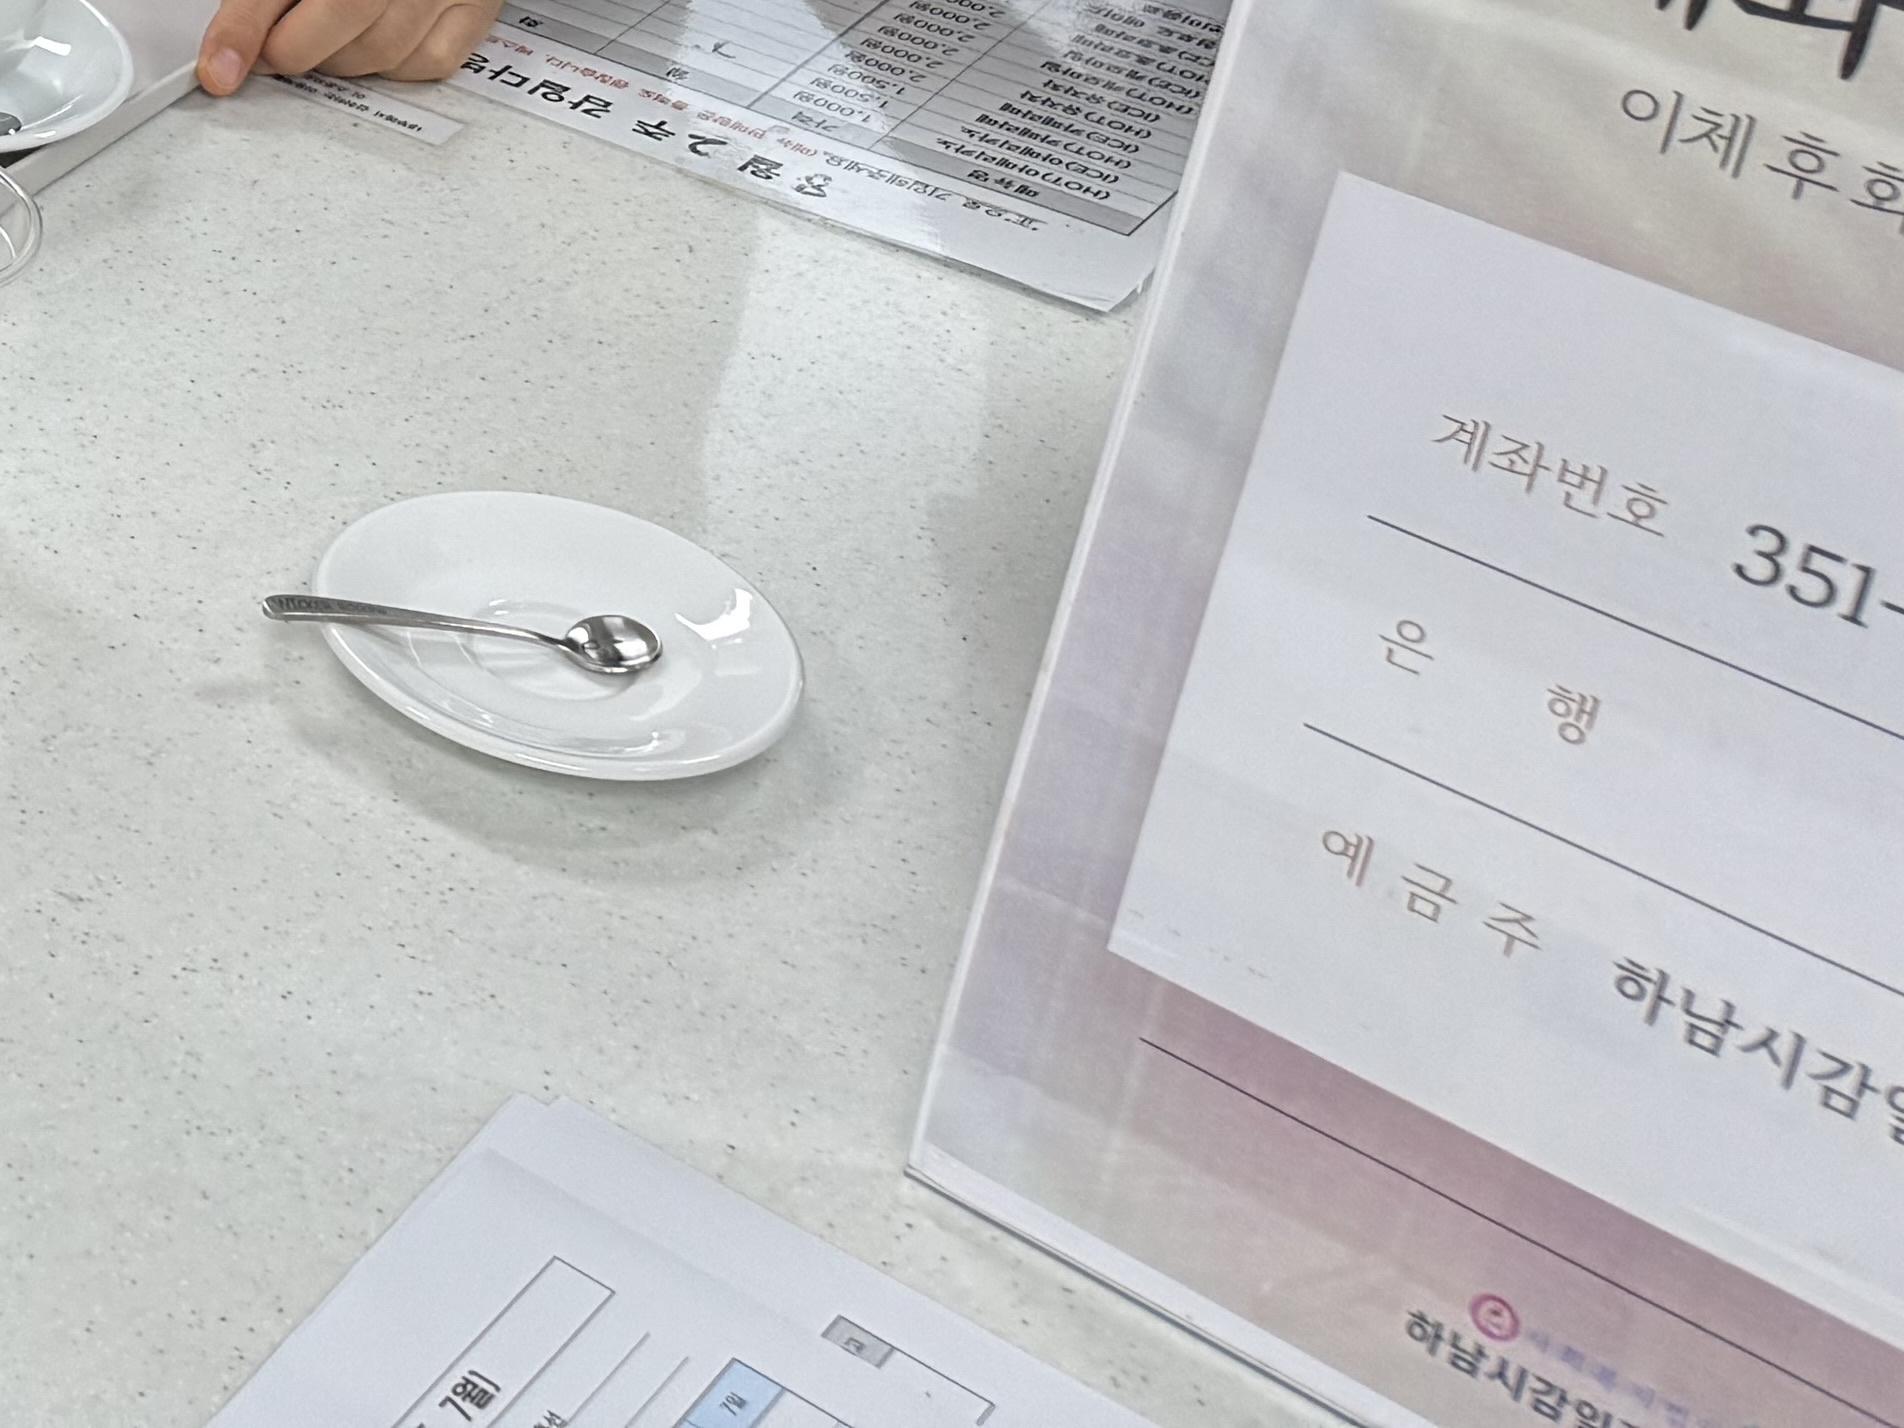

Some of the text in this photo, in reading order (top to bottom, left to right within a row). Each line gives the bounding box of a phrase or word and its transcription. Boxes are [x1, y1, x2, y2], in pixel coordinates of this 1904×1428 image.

[790, 111, 838, 132] 가격
[1020, 90, 1151, 139] (HOT)유자차
[1042, 79, 1160, 122] (ICE)유자차
[937, 138, 1110, 200] (HOT)아메리카노
[961, 127, 1118, 183] (ICE)아메리카노
[1620, 88, 1757, 178] 이체
[1764, 130, 1840, 200] 후
[967, 169, 1039, 197] 메뉴명
[1432, 413, 1904, 628] 계좌번호 351-
[1405, 1309, 1645, 1428] 하남시감일
